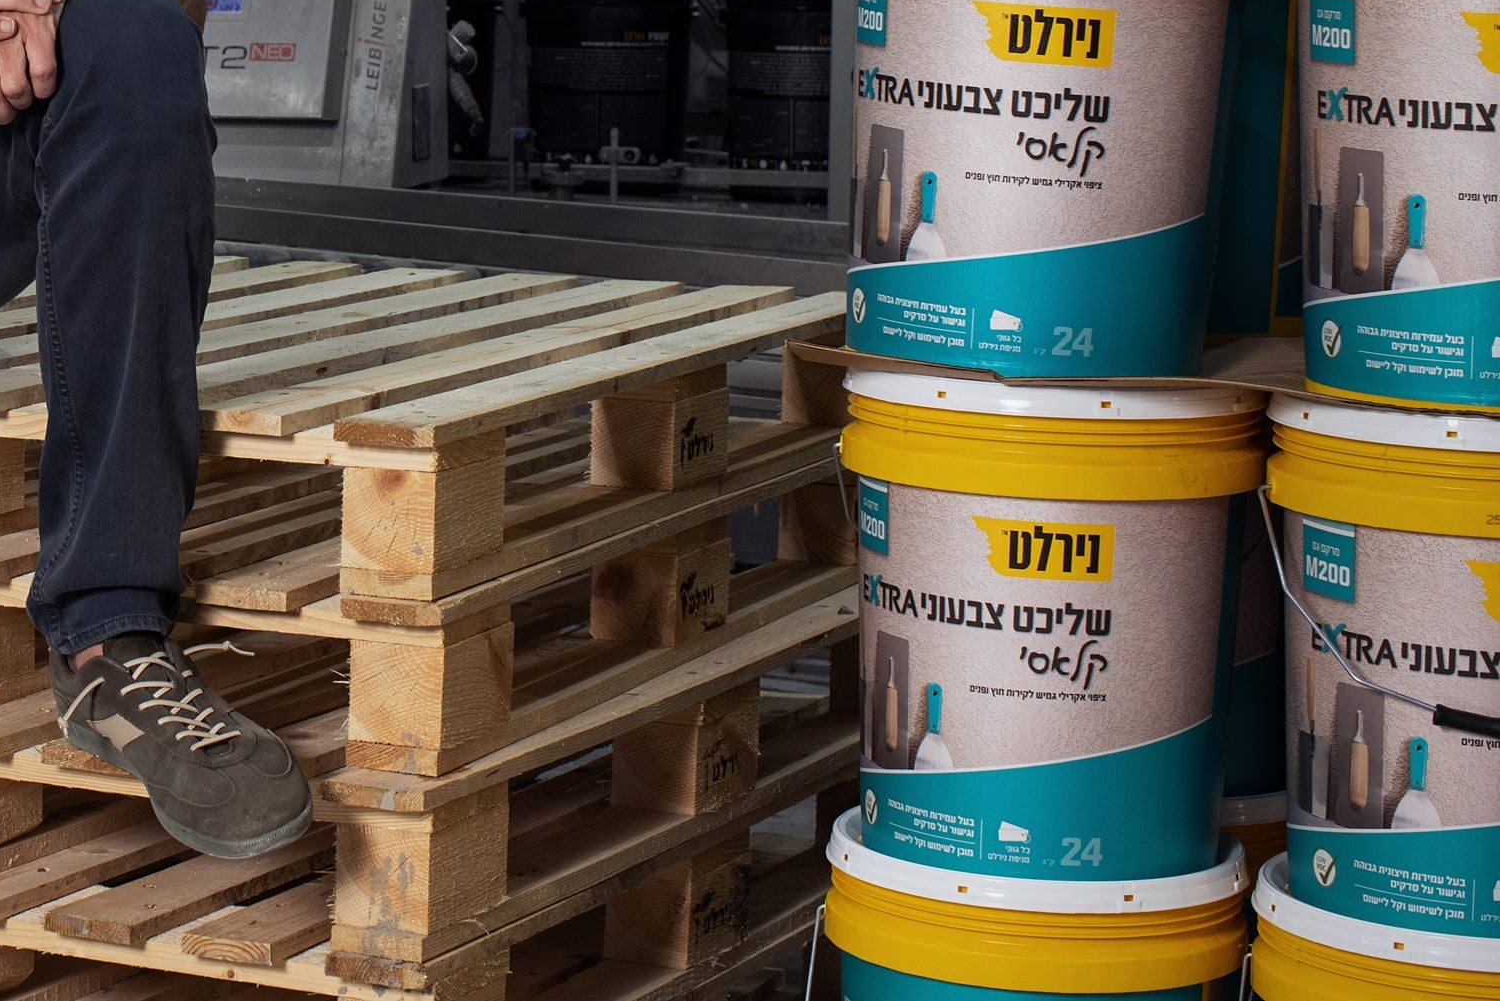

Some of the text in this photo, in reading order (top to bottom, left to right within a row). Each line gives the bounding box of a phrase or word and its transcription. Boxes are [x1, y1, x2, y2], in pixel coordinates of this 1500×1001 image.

[858, 6, 883, 31] M200
[1008, 9, 1101, 59] נירלט
[1312, 24, 1350, 49] M200
[251, 44, 295, 60] NEO
[858, 67, 915, 106] EXTRA
[917, 80, 1002, 116] צבעוני
[1011, 87, 1110, 123] שליכט
[1317, 87, 1498, 132] צבעוני EXTRA
[965, 172, 1102, 190] ציפוי אקרילי גמיש לקירות חוץ ופנים
[1458, 192, 1498, 204] חוץ ופנים
[921, 302, 948, 314] עמידות
[949, 305, 966, 316] בעל
[928, 312, 940, 323] על
[902, 329, 916, 341] וקל
[917, 331, 946, 344] לשימוש
[1011, 335, 1022, 343] כל
[1051, 326, 1094, 357] 24
[1357, 325, 1465, 345] בעל עמידות חיצונית גבוהה
[948, 338, 965, 348] מוכן
[978, 341, 1021, 353] מניפת נירלט
[1420, 343, 1434, 354] על
[1435, 346, 1464, 356] וגישור
[1366, 359, 1464, 379] מוכן לשימוש וקל ליישום
[861, 510, 885, 540] M200
[1008, 526, 1100, 573] נירלט
[1306, 554, 1350, 587] M200
[864, 573, 1112, 636] שליכט צבעוני EXTRA
[1311, 623, 1500, 679] צבעוני EXTRA
[969, 685, 1107, 703] ציפוי אקרילי גמיש לקירות חוץ ופנים
[1461, 738, 1484, 747] ופנים
[929, 809, 956, 823] עמידות
[958, 815, 975, 826] בעל
[937, 821, 948, 833] על
[913, 836, 927, 849] וקל
[927, 839, 955, 853] לשימוש
[1019, 845, 1030, 854] כל
[957, 848, 974, 858] מוכן
[987, 851, 1030, 864] מניפת נירלט
[1060, 837, 1103, 867] 24
[1353, 859, 1466, 887] בעל עמידות חיצונית גבוהה
[1420, 883, 1434, 894] על
[1438, 887, 1465, 899] וגישור
[1362, 893, 1464, 920] מוכן לשימוש וקל ליישום
